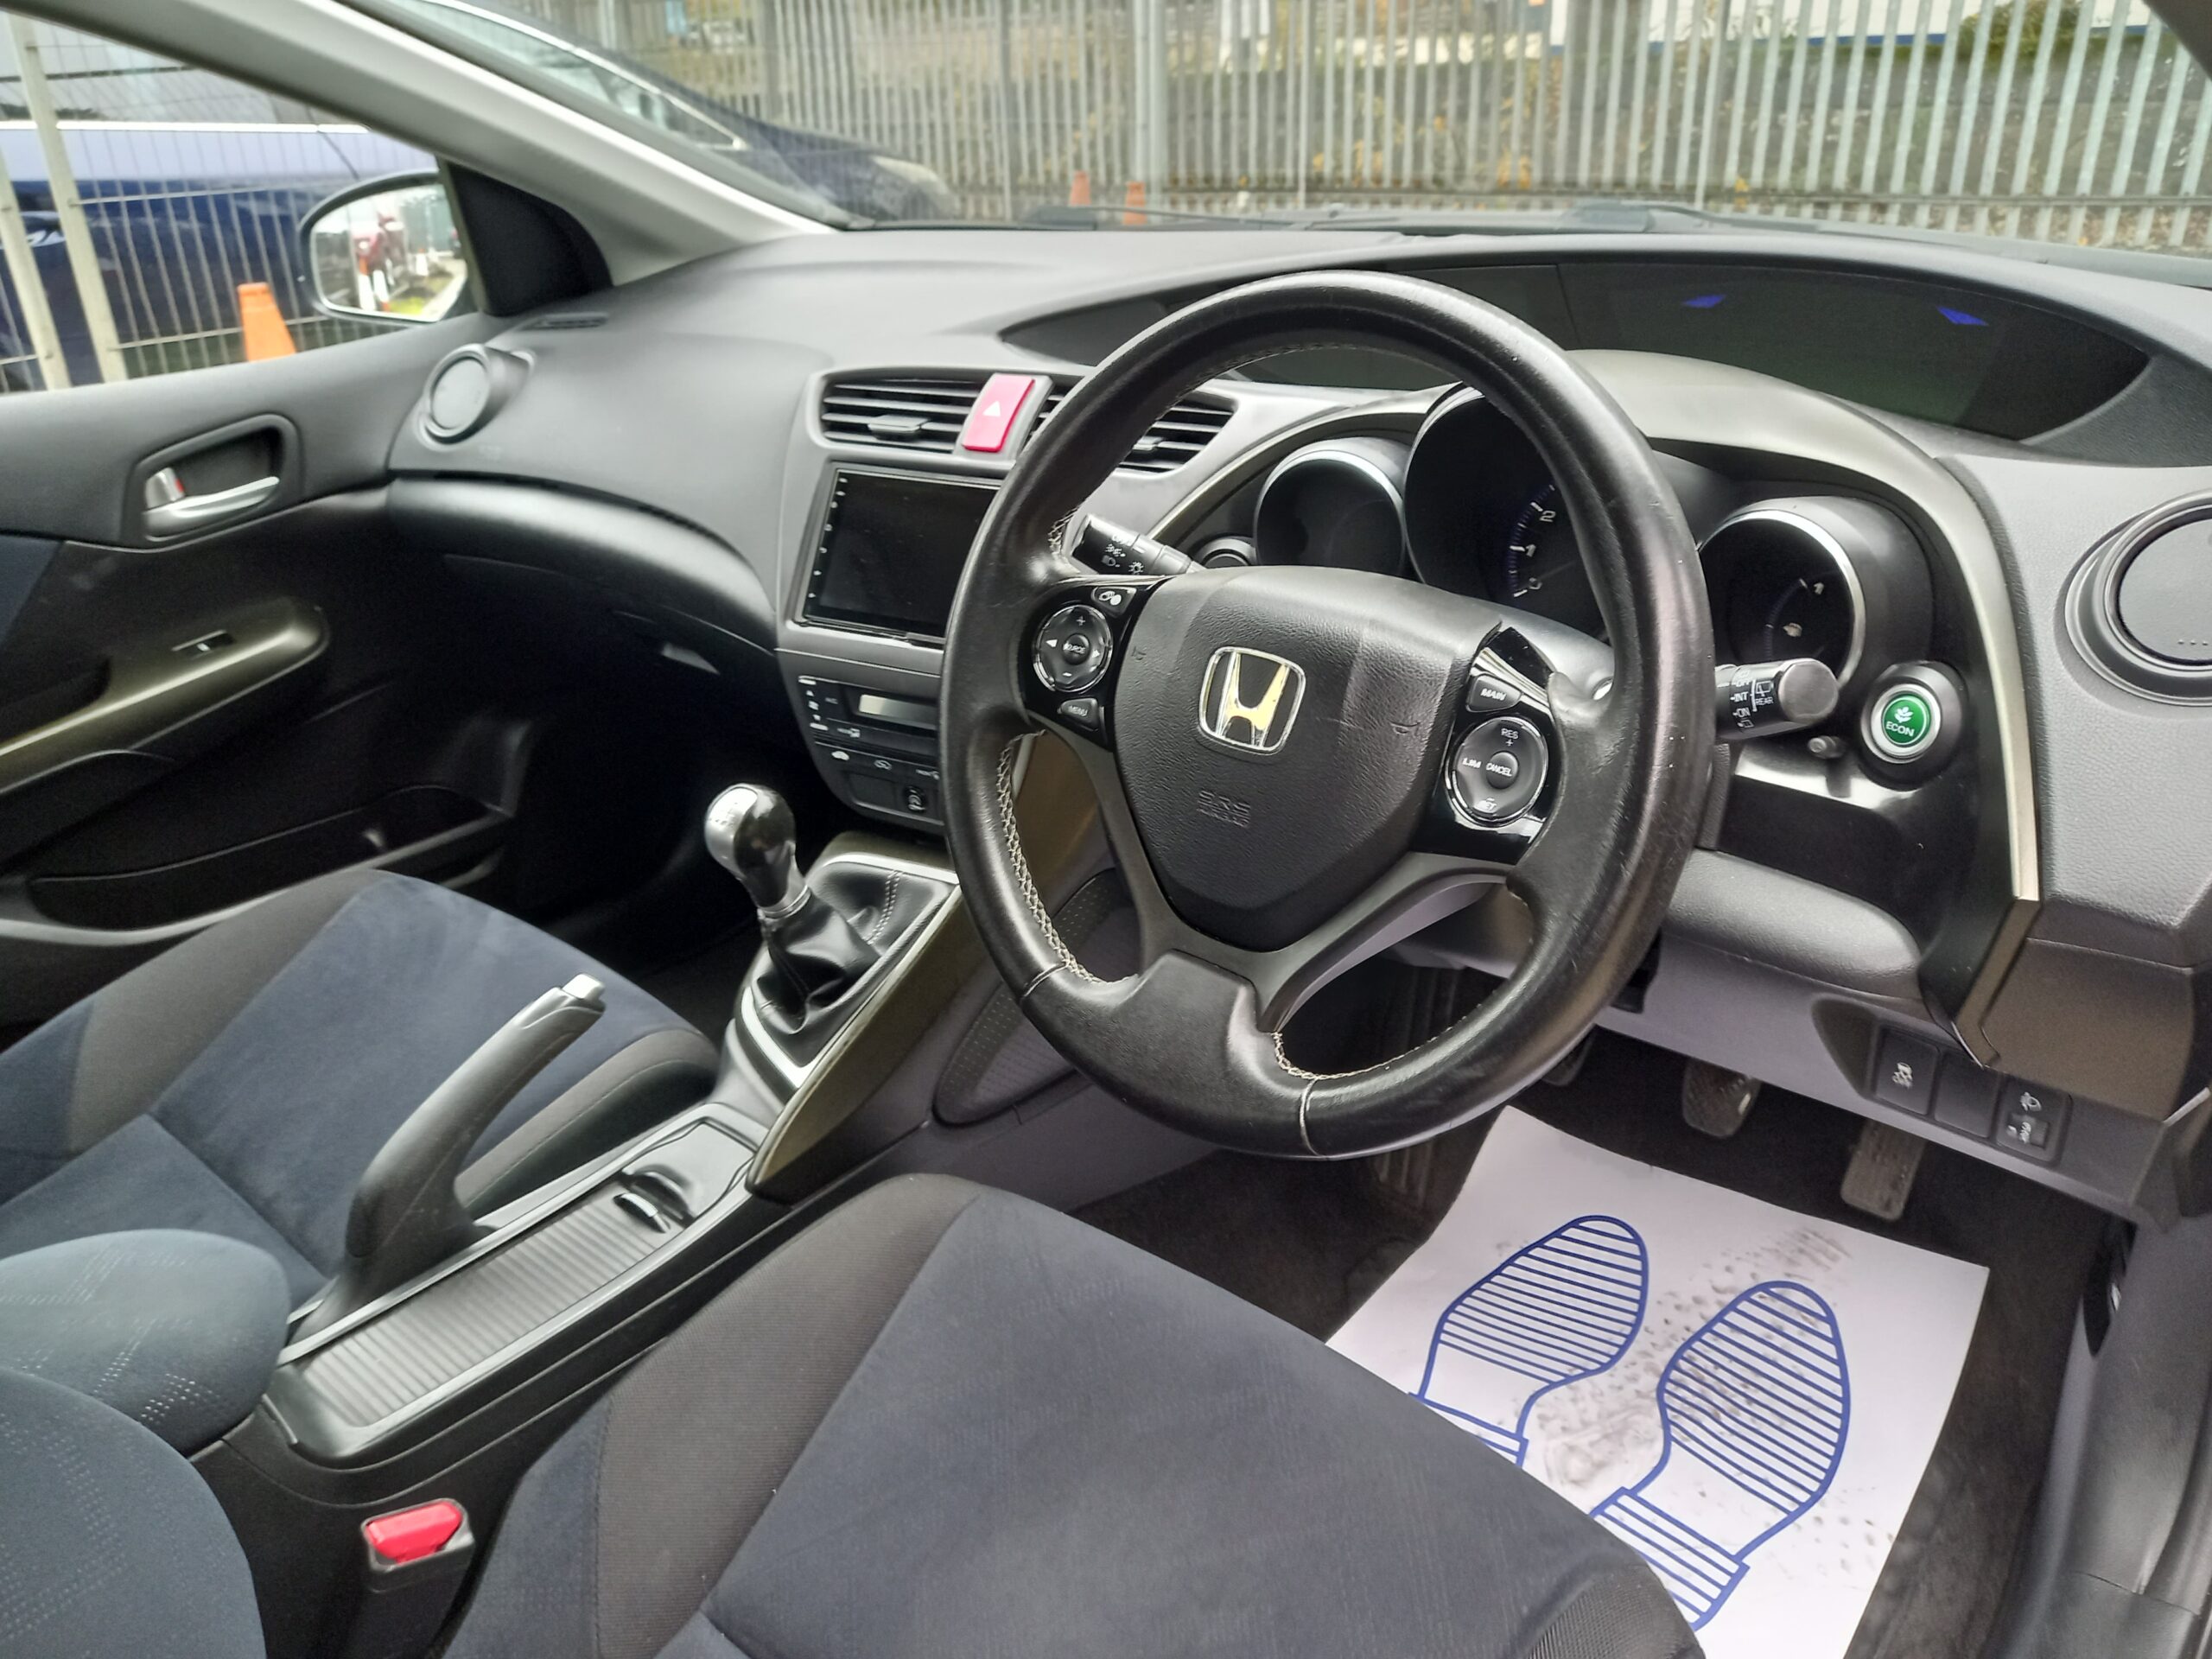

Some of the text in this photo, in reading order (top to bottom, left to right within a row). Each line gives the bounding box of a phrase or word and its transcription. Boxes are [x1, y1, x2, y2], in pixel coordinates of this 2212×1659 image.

[1540, 510, 1556, 523] 2
[1525, 543, 1536, 557] 1
[1481, 688, 1506, 702] MAIN
[1755, 696, 1774, 706] REAR
[1736, 707, 1751, 718] ON
[1501, 728, 1519, 740] RES
[1885, 721, 1915, 738] ECON
